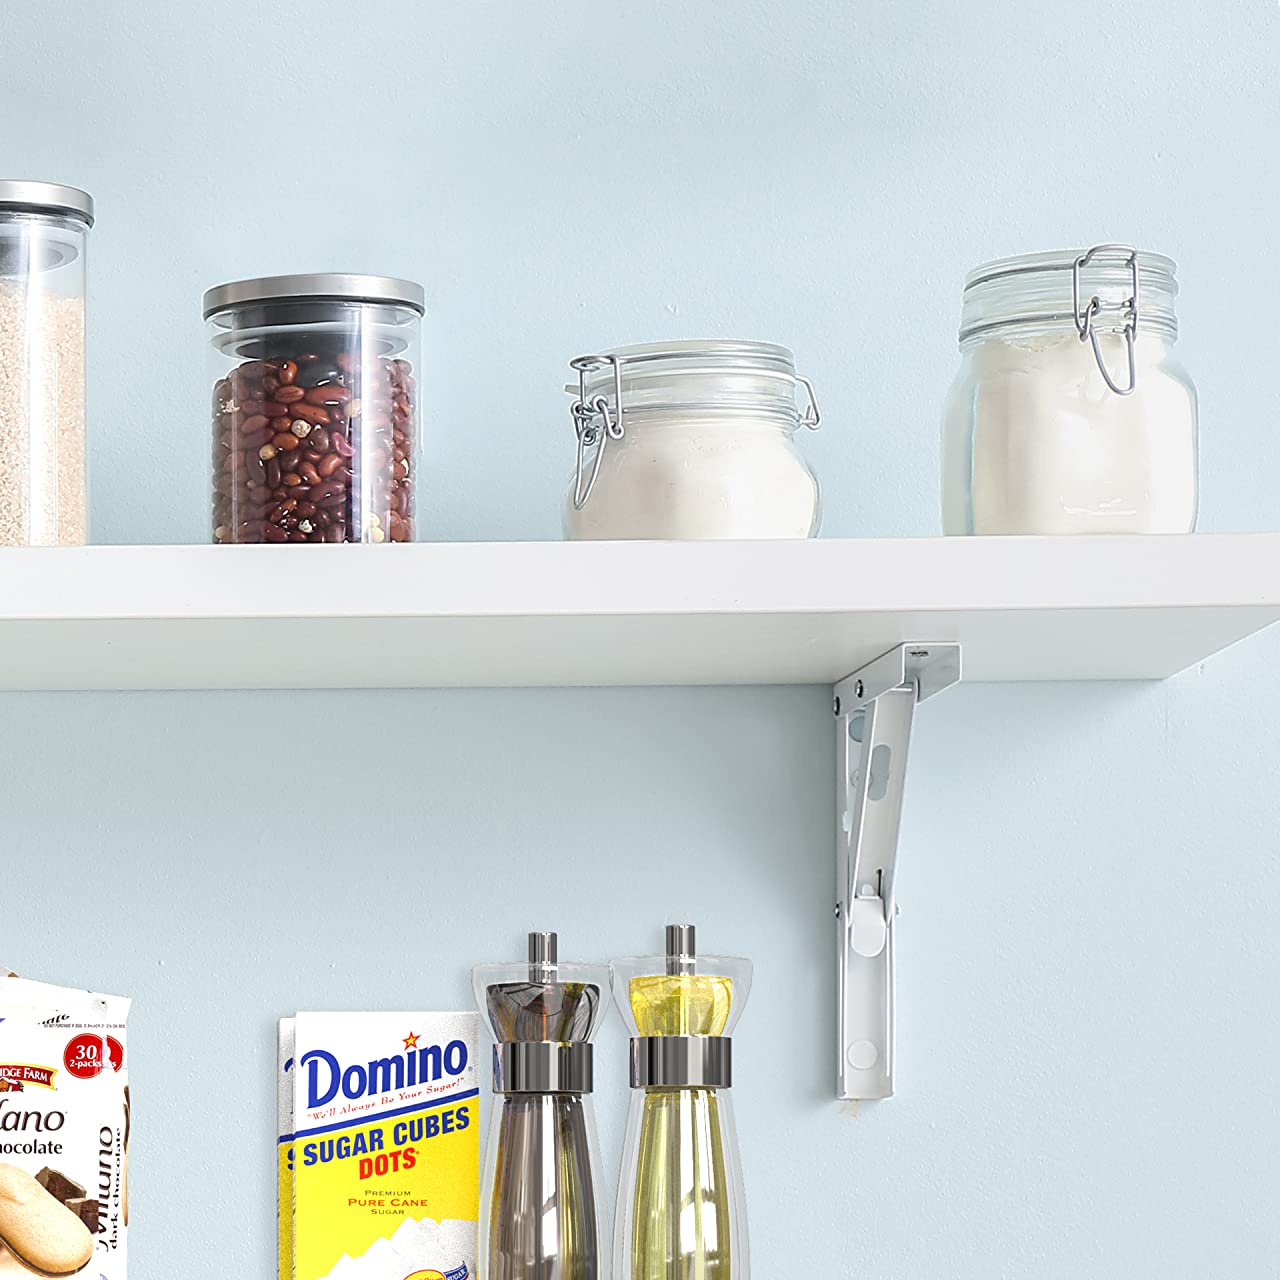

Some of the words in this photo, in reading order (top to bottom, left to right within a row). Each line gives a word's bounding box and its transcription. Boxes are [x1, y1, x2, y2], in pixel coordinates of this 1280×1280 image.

[75, 1045, 97, 1060] 30
[23, 1067, 48, 1082] FARM
[70, 1060, 102, 1070] 2-packs
[300, 1039, 468, 1109] Domino
[340, 1101, 376, 1115] Always
[381, 1096, 394, 1105] Be
[398, 1090, 423, 1101] Your
[303, 1128, 384, 1166] SUGAR
[393, 1106, 470, 1146] CUBES
[359, 1147, 416, 1180] DOTS
[348, 1199, 385, 1207] PURE
[391, 1199, 428, 1207] CANE
